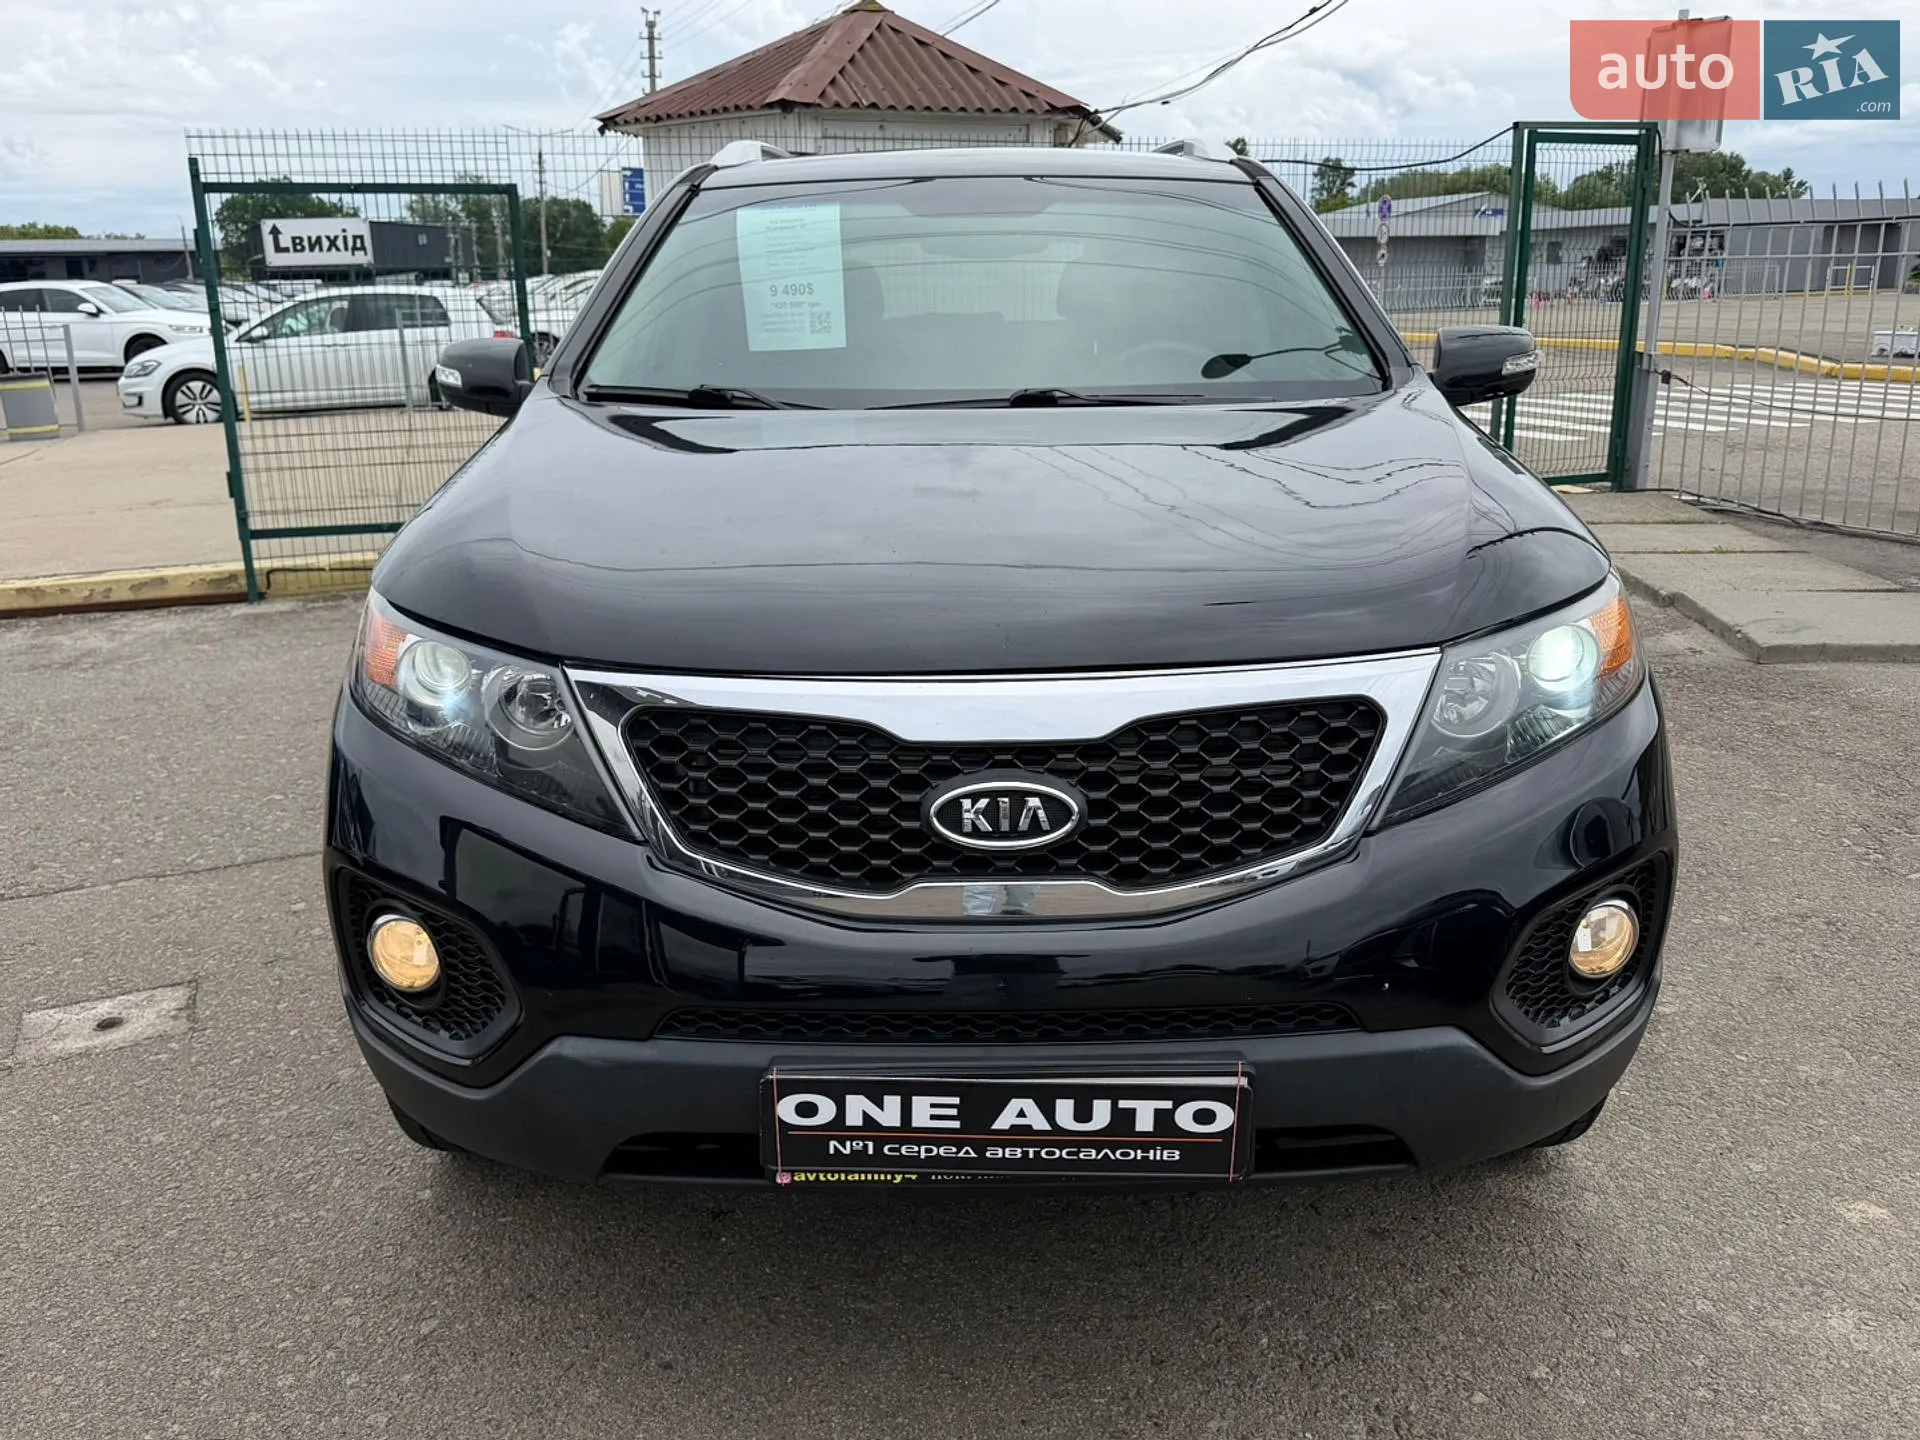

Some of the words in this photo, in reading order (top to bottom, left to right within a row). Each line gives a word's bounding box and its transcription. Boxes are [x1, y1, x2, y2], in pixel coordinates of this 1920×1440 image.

[291, 228, 367, 256] вихід
[769, 284, 778, 297] 9
[782, 282, 814, 296] 490$
[959, 797, 1050, 832] KIA
[777, 1093, 960, 1128] ONE
[990, 1098, 1235, 1133] AUTO
[883, 1143, 977, 1159] серед
[985, 1146, 1181, 1161] автосалонів
